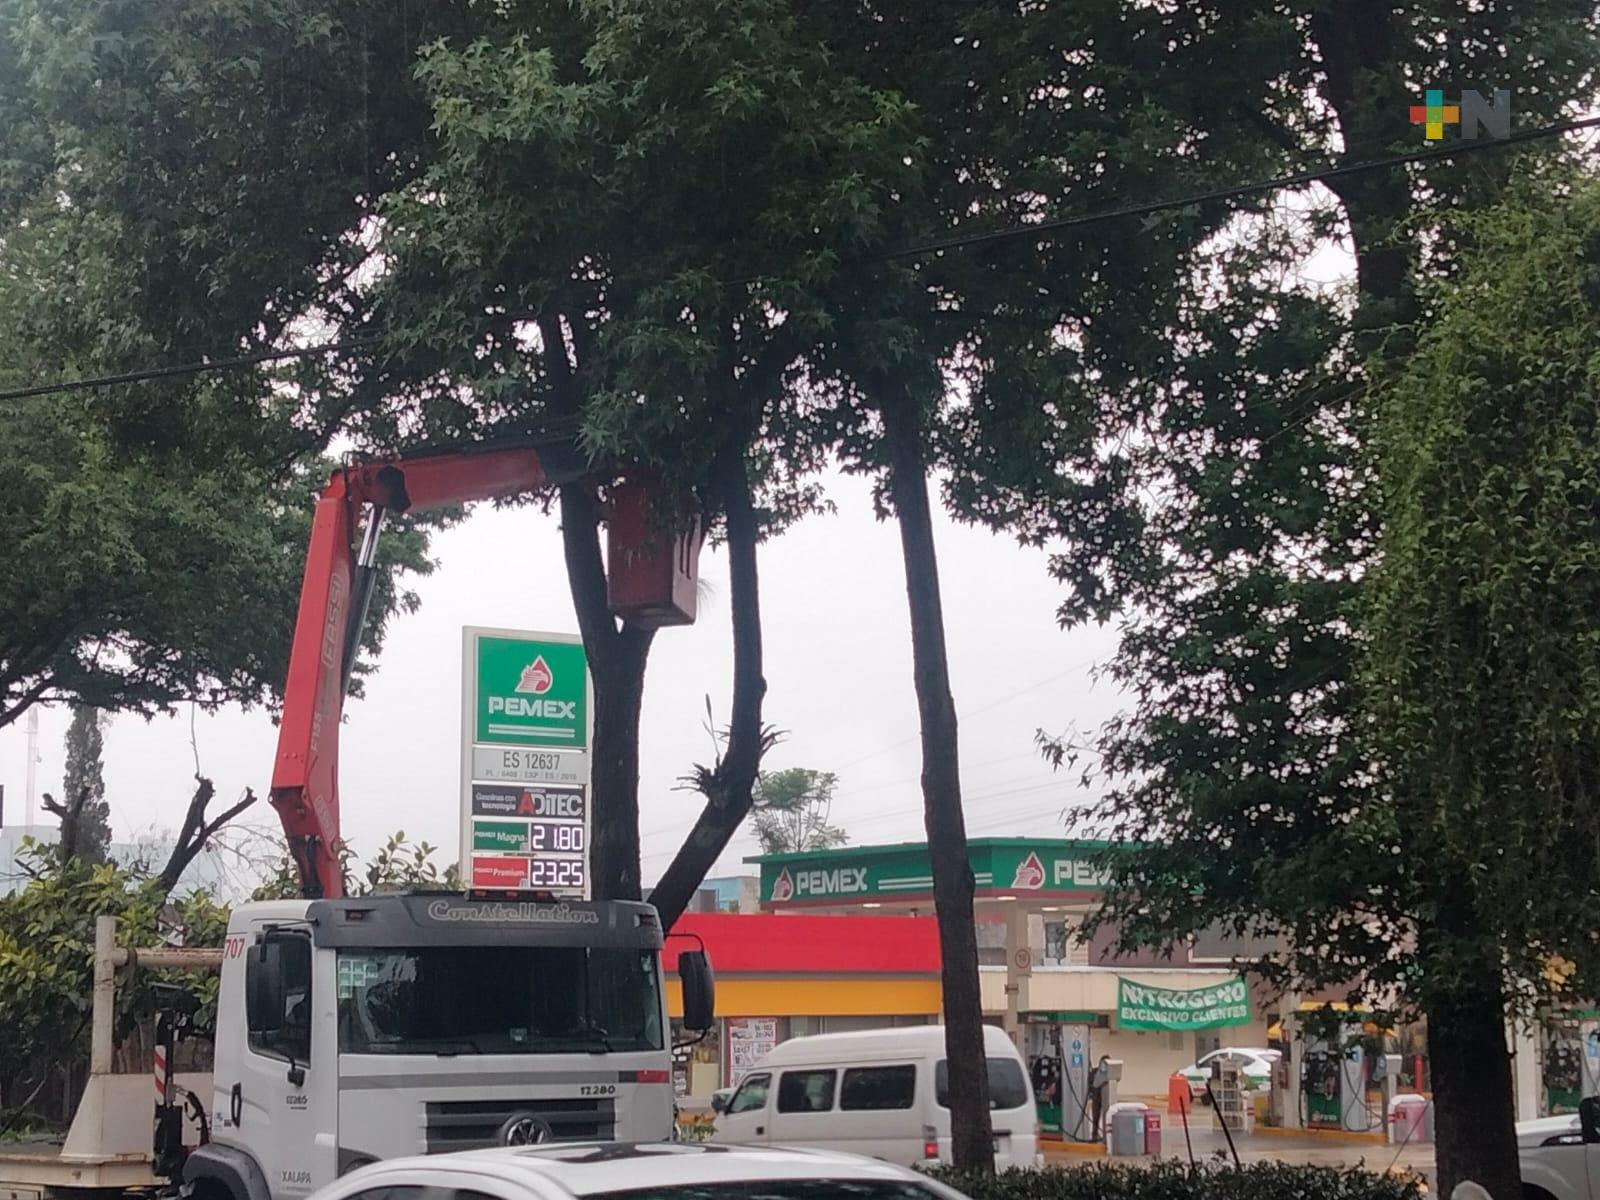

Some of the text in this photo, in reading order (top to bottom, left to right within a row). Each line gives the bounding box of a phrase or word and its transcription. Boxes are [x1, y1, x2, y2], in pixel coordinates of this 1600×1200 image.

[488, 695, 576, 719] PEMEX
[503, 751, 561, 771] ES 12637
[497, 831, 525, 844] Magna
[797, 867, 868, 895] PEMEX
[428, 900, 599, 923] Constellation
[224, 938, 245, 959] 707
[1121, 1005, 1248, 1023] EXCLUSIVO CLIENTES
[281, 1170, 312, 1184] XALAPA
